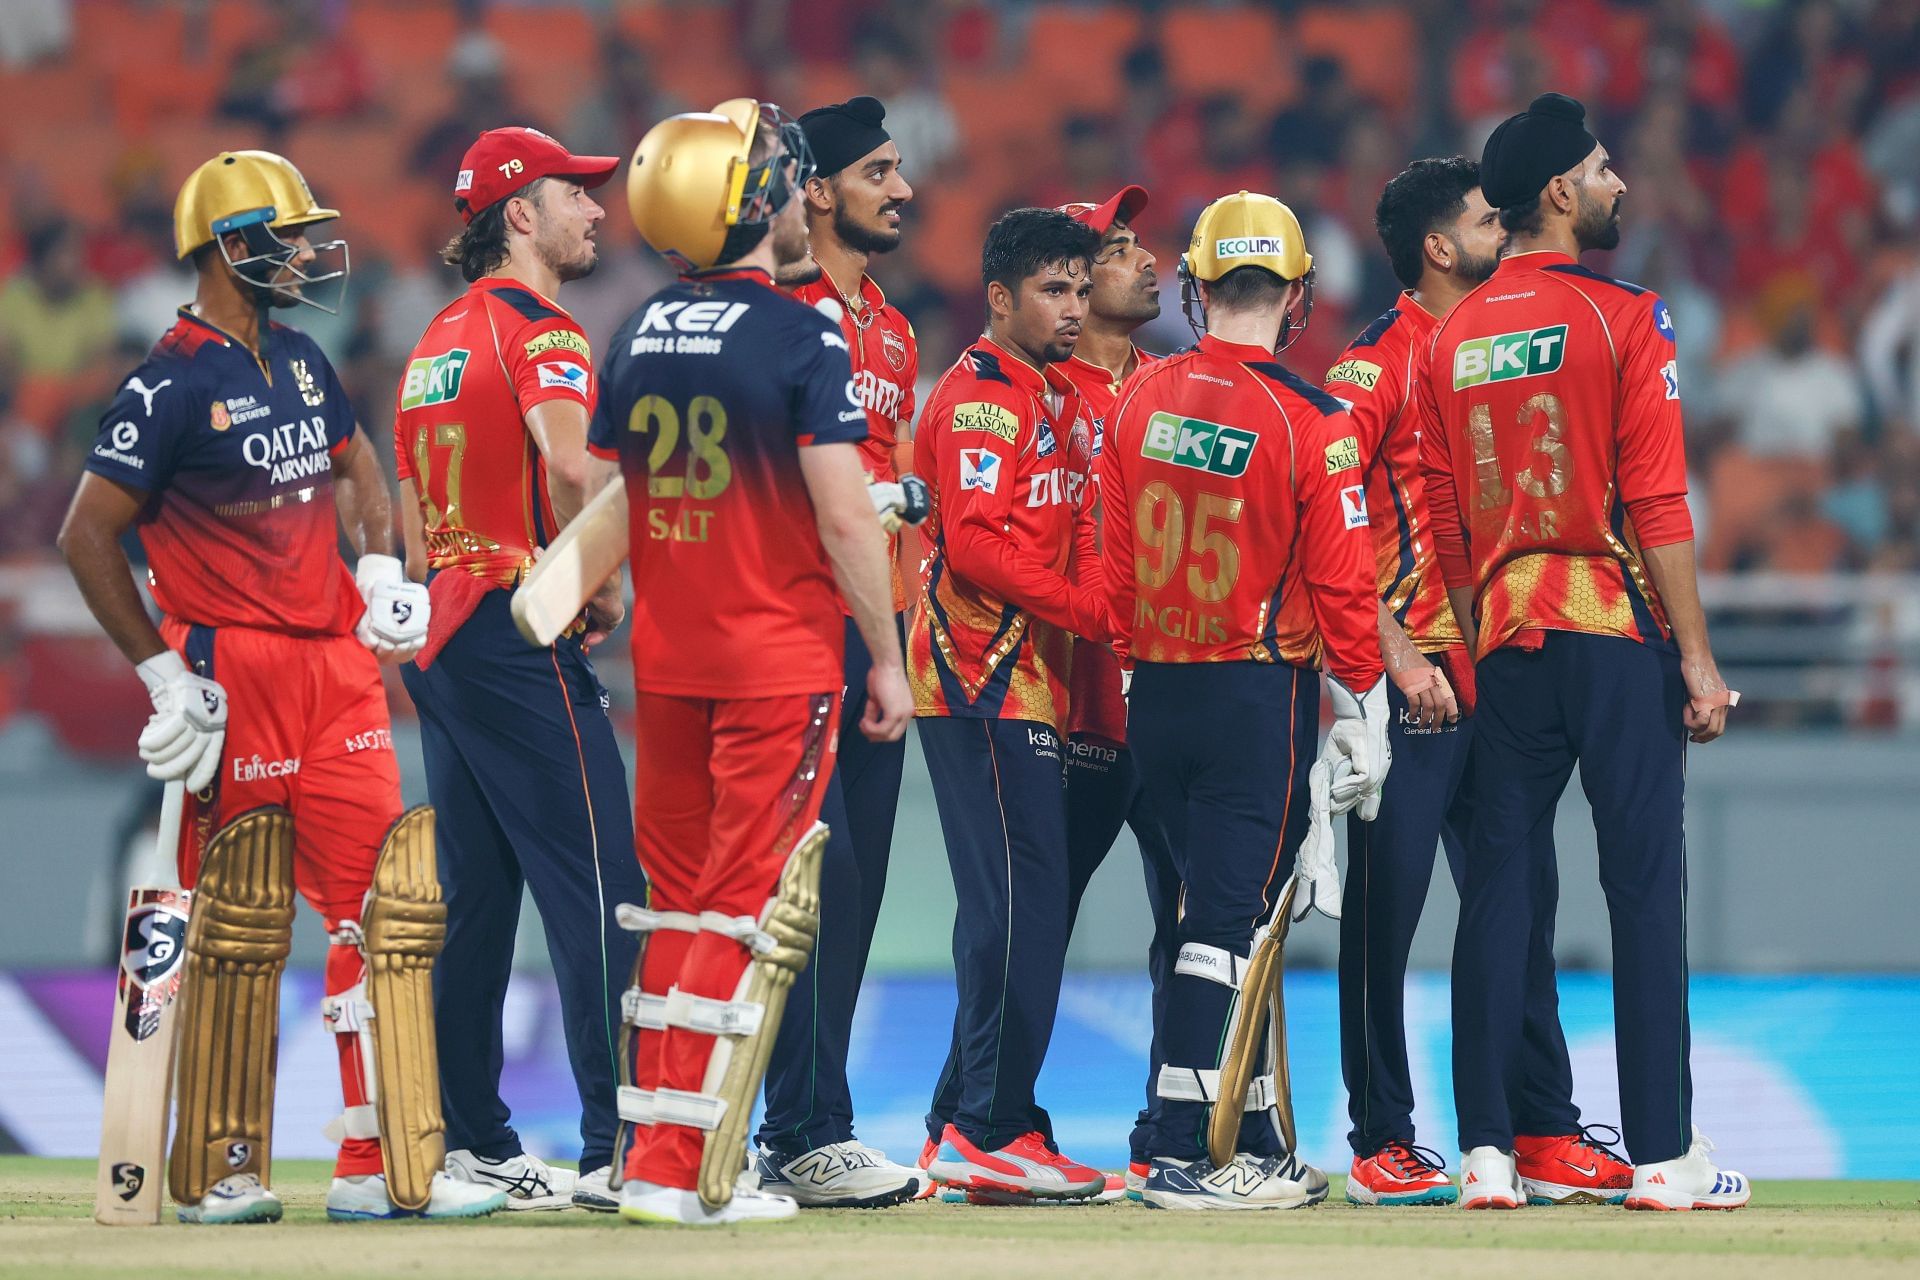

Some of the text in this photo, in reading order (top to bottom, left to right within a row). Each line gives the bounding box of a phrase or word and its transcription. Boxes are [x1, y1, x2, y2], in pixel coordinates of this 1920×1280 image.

[499, 158, 524, 179] 79
[1219, 239, 1280, 255] ECOLINK
[636, 301, 751, 335] KEI
[1457, 335, 1561, 378] BKT
[403, 359, 464, 400] BKT
[954, 413, 1017, 441] SEASONS
[976, 402, 1004, 419] ALL
[242, 416, 329, 470] QATAR
[628, 393, 732, 500] 28
[1147, 420, 1250, 467] BKT
[1467, 391, 1575, 511] 13
[270, 449, 332, 486] AIRWAYS
[413, 421, 468, 530] 17
[648, 508, 715, 543] SALT
[1135, 480, 1245, 603] 95
